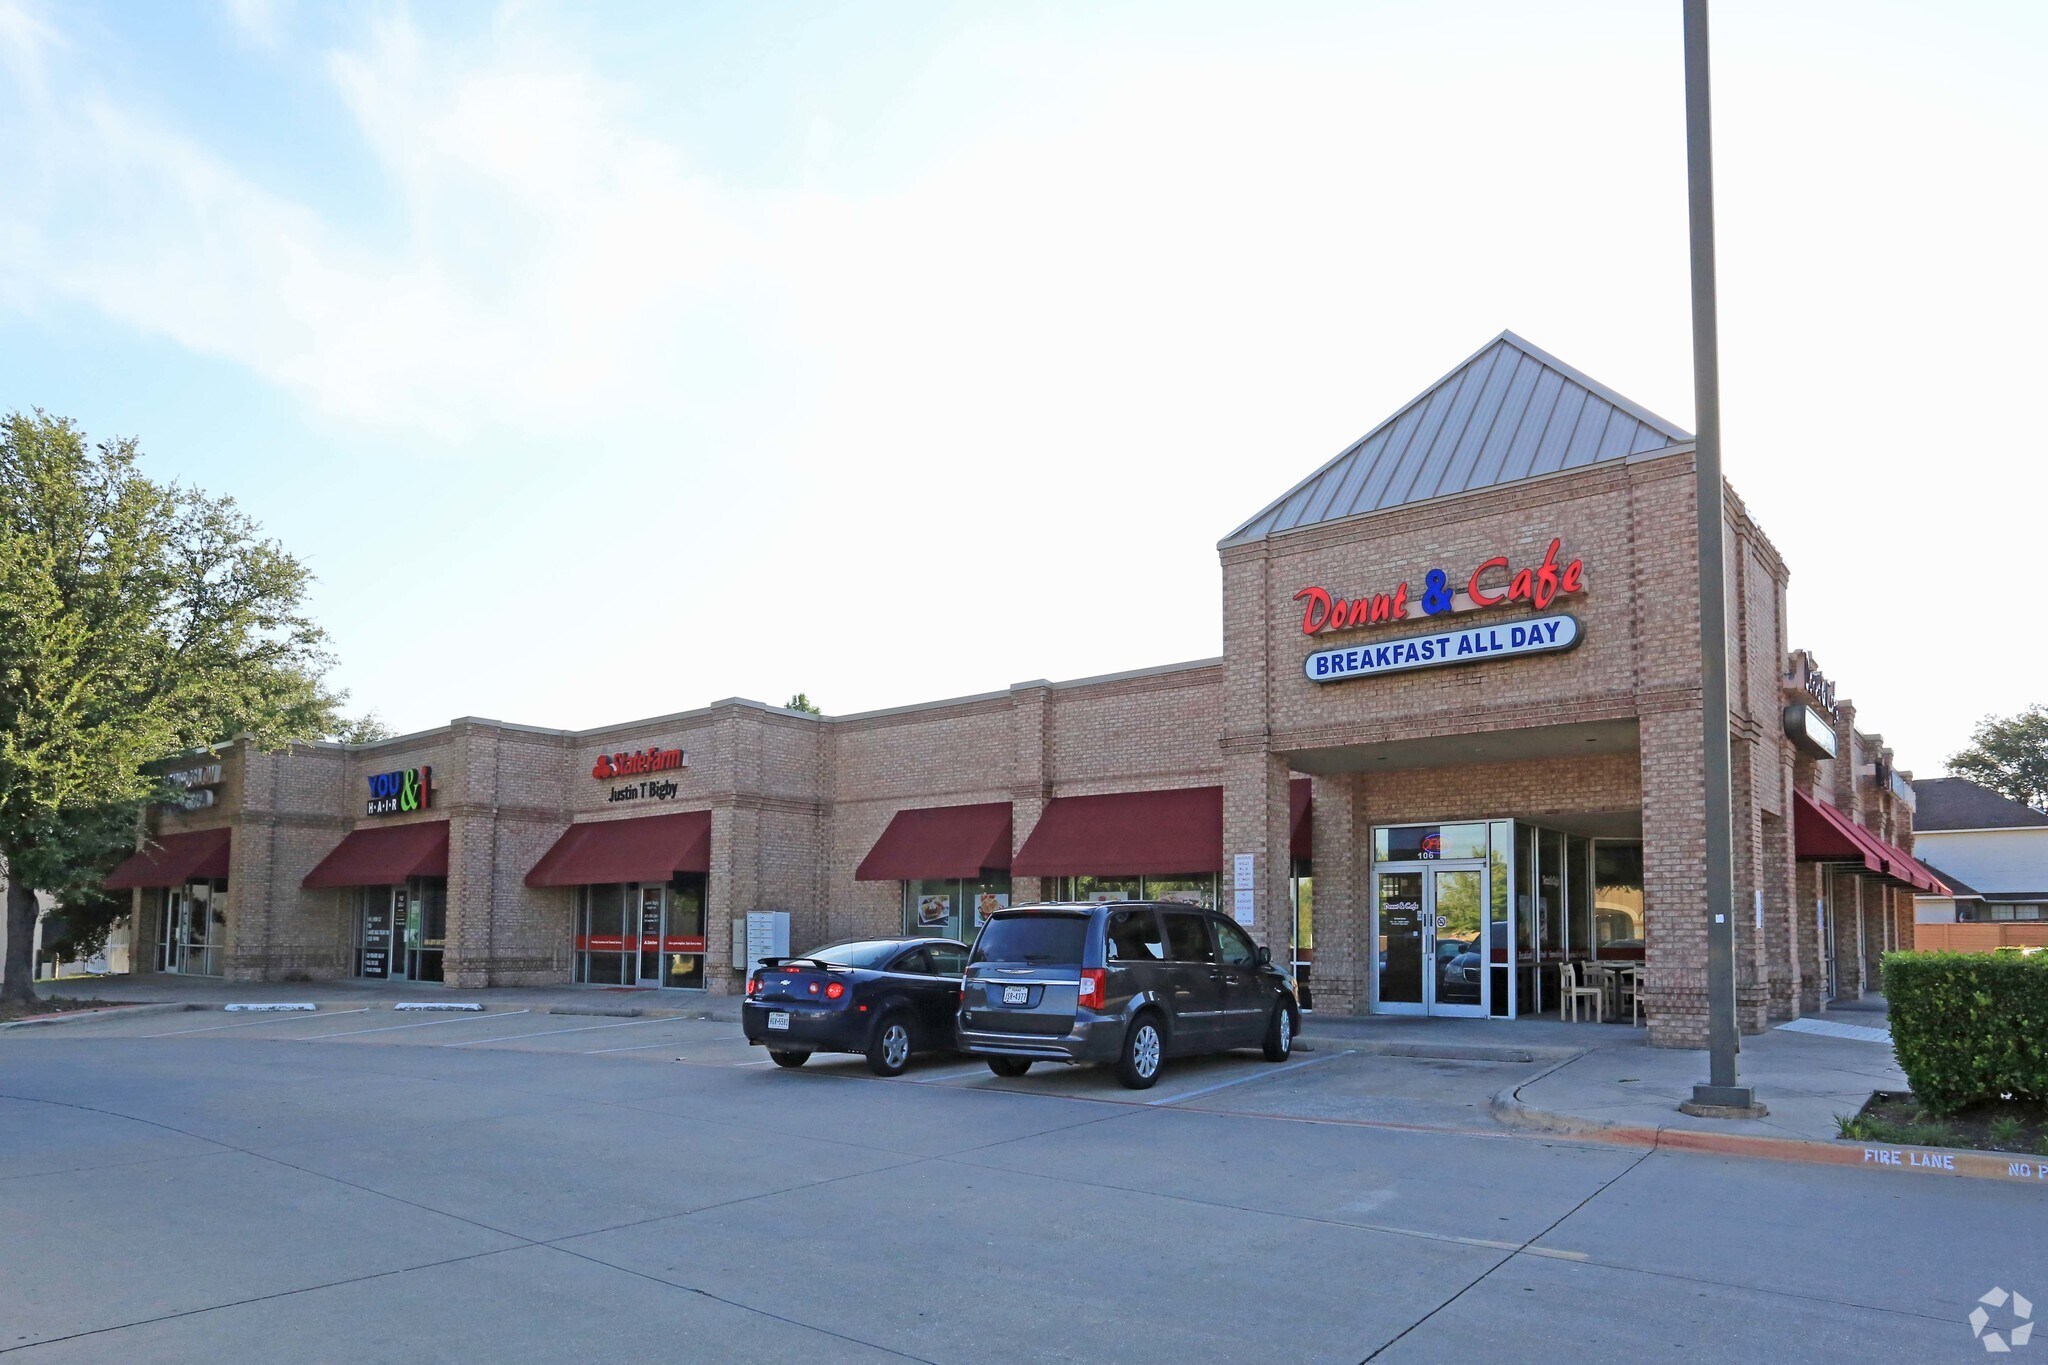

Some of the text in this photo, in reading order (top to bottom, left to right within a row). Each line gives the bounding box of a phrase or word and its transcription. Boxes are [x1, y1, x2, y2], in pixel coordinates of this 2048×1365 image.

[1293, 537, 1583, 636] Donut & Cafe
[1315, 620, 1561, 676] BREAKFAST ALL DAY
[367, 771, 401, 798] YOU
[400, 767, 419, 812] &
[608, 780, 678, 803] Justin T Bigby
[1417, 852, 1434, 860] 106
[1864, 1149, 1902, 1165] FIRE
[1910, 1153, 1955, 1170] LANE
[2008, 1162, 2031, 1177] NO
